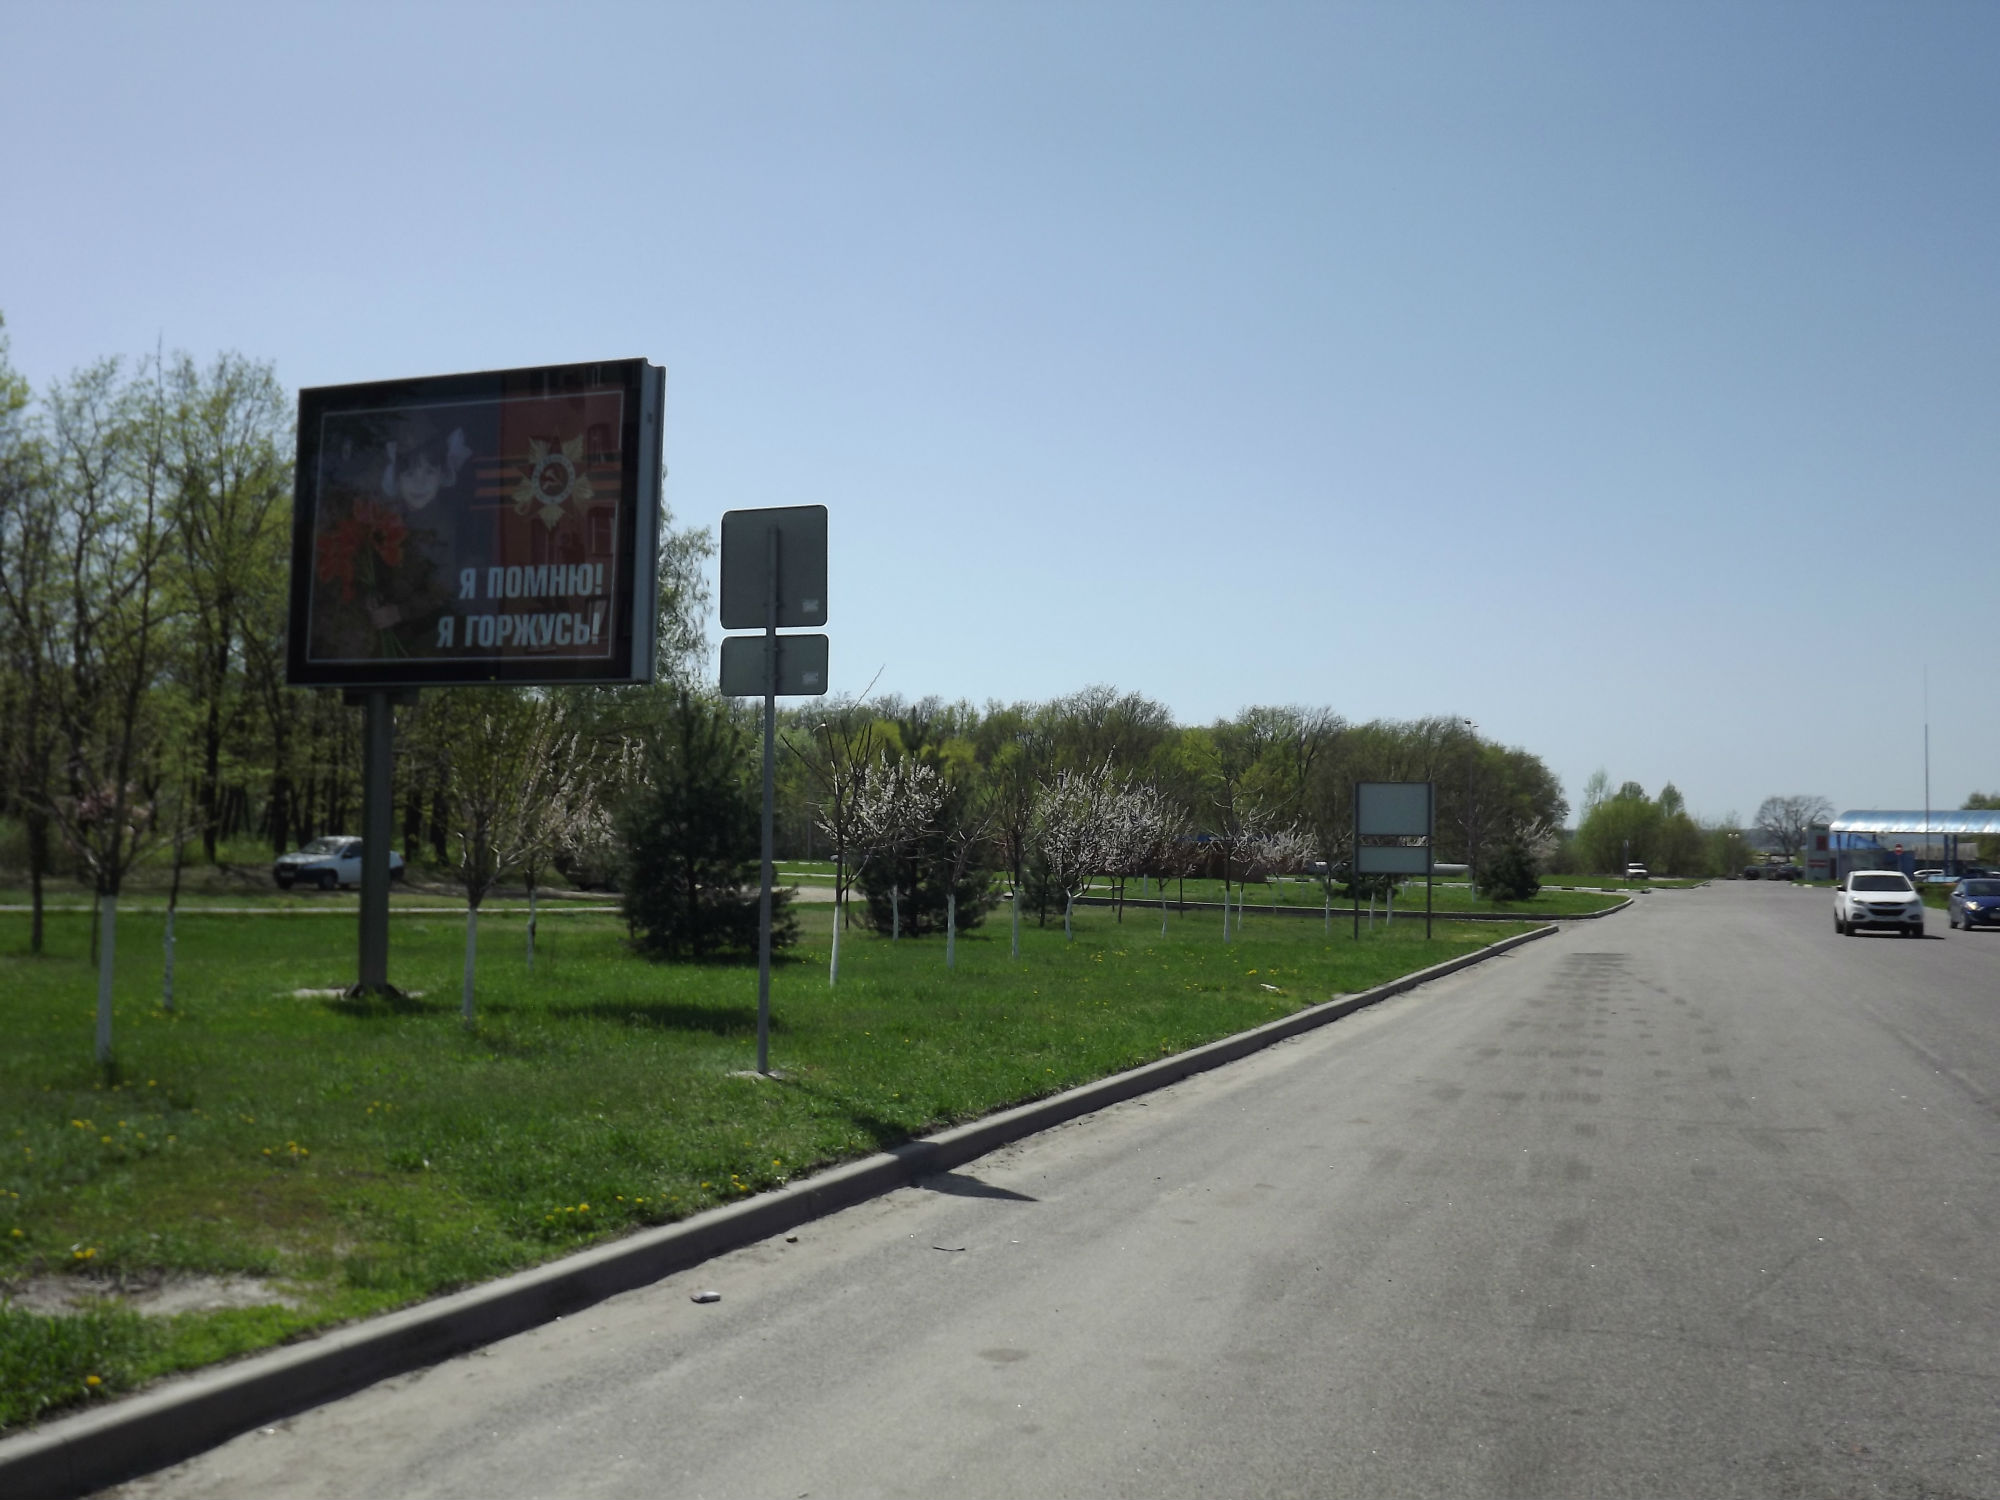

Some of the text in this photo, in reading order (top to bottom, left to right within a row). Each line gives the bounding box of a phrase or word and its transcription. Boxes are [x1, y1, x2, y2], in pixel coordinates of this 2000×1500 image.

[459, 563, 604, 599] Я ПОМНЮ!
[437, 612, 600, 648] Я ГОРЖУСЬ!
